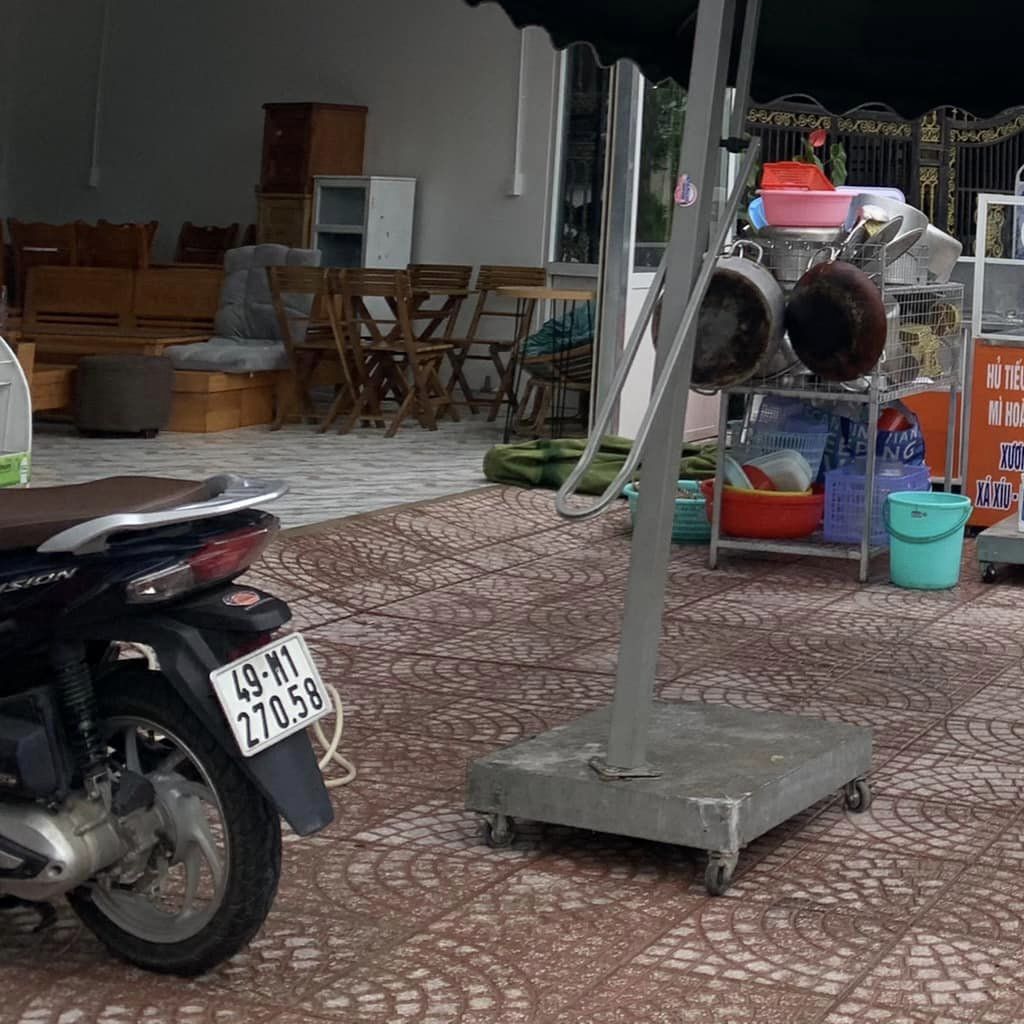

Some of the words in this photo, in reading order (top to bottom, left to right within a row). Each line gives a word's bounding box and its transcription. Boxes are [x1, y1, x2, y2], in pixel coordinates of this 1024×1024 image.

[986, 356, 1001, 389] HỦ
[988, 396, 1002, 426] MÌ
[992, 477, 1012, 510] XÍU
[237, 677, 323, 748] 270.58
